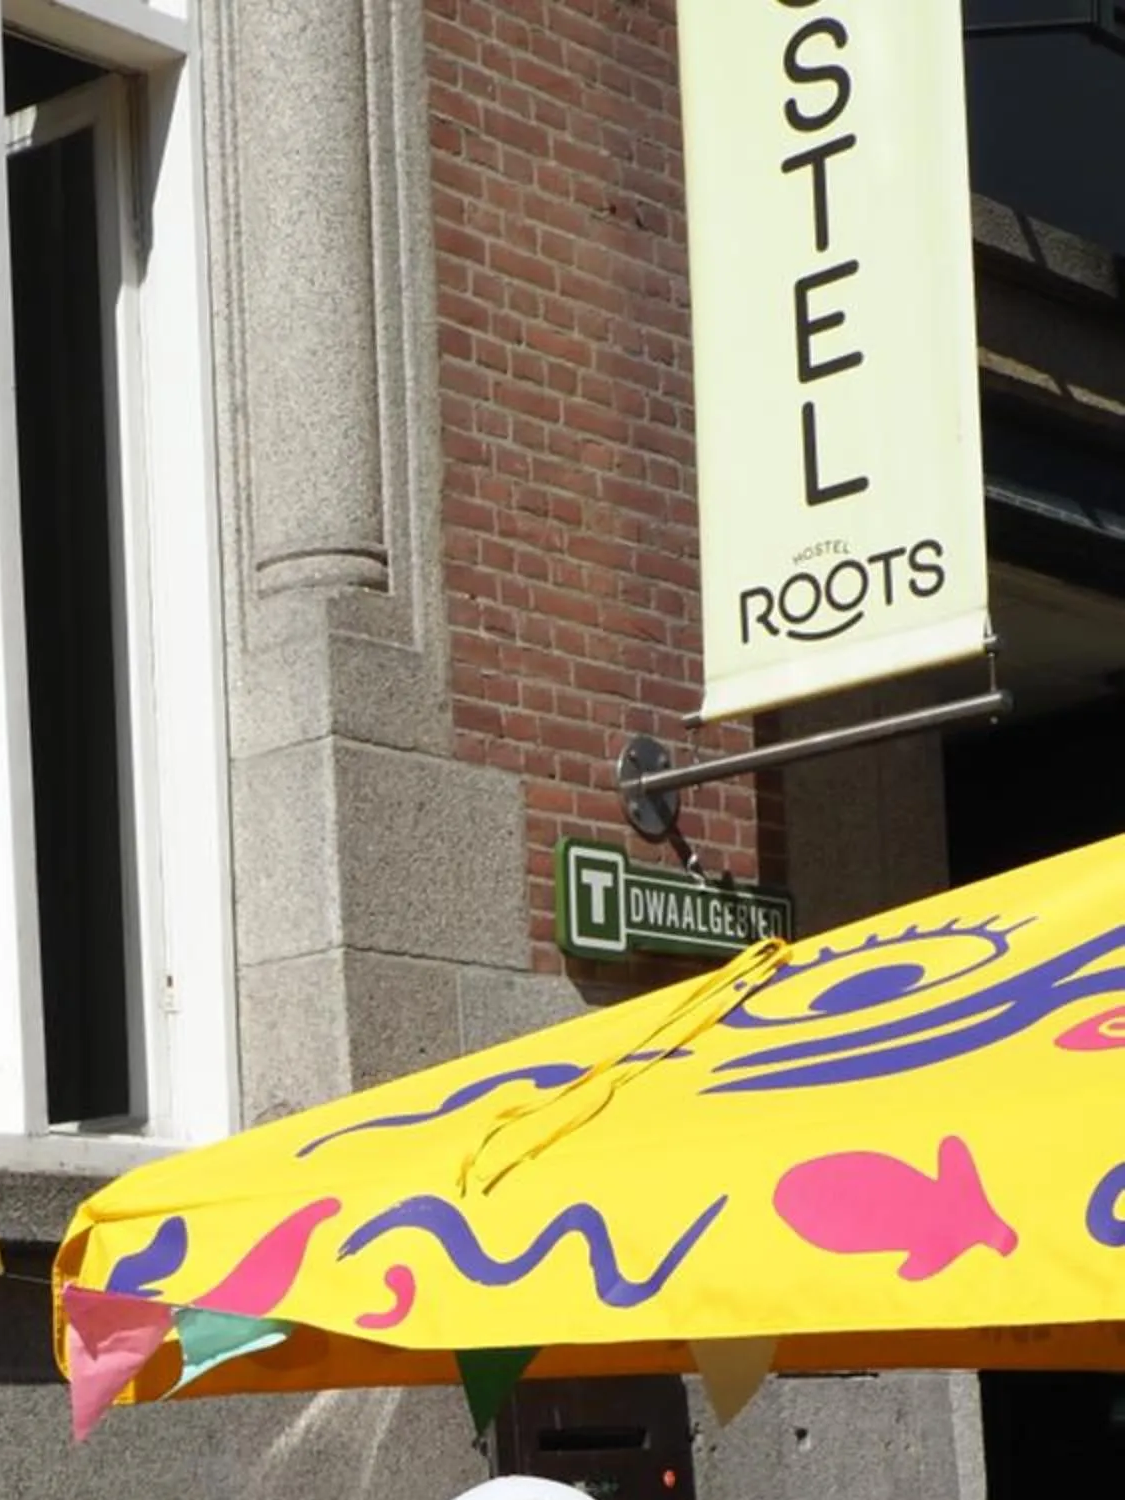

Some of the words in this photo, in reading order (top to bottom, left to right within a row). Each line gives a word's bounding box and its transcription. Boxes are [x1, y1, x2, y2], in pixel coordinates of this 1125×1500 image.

[780, 0, 869, 506] STEL
[739, 538, 946, 644] ROOTS
[792, 540, 851, 566] HOSTEL
[581, 868, 614, 924] T
[630, 887, 782, 939] DWAALGEBIED
